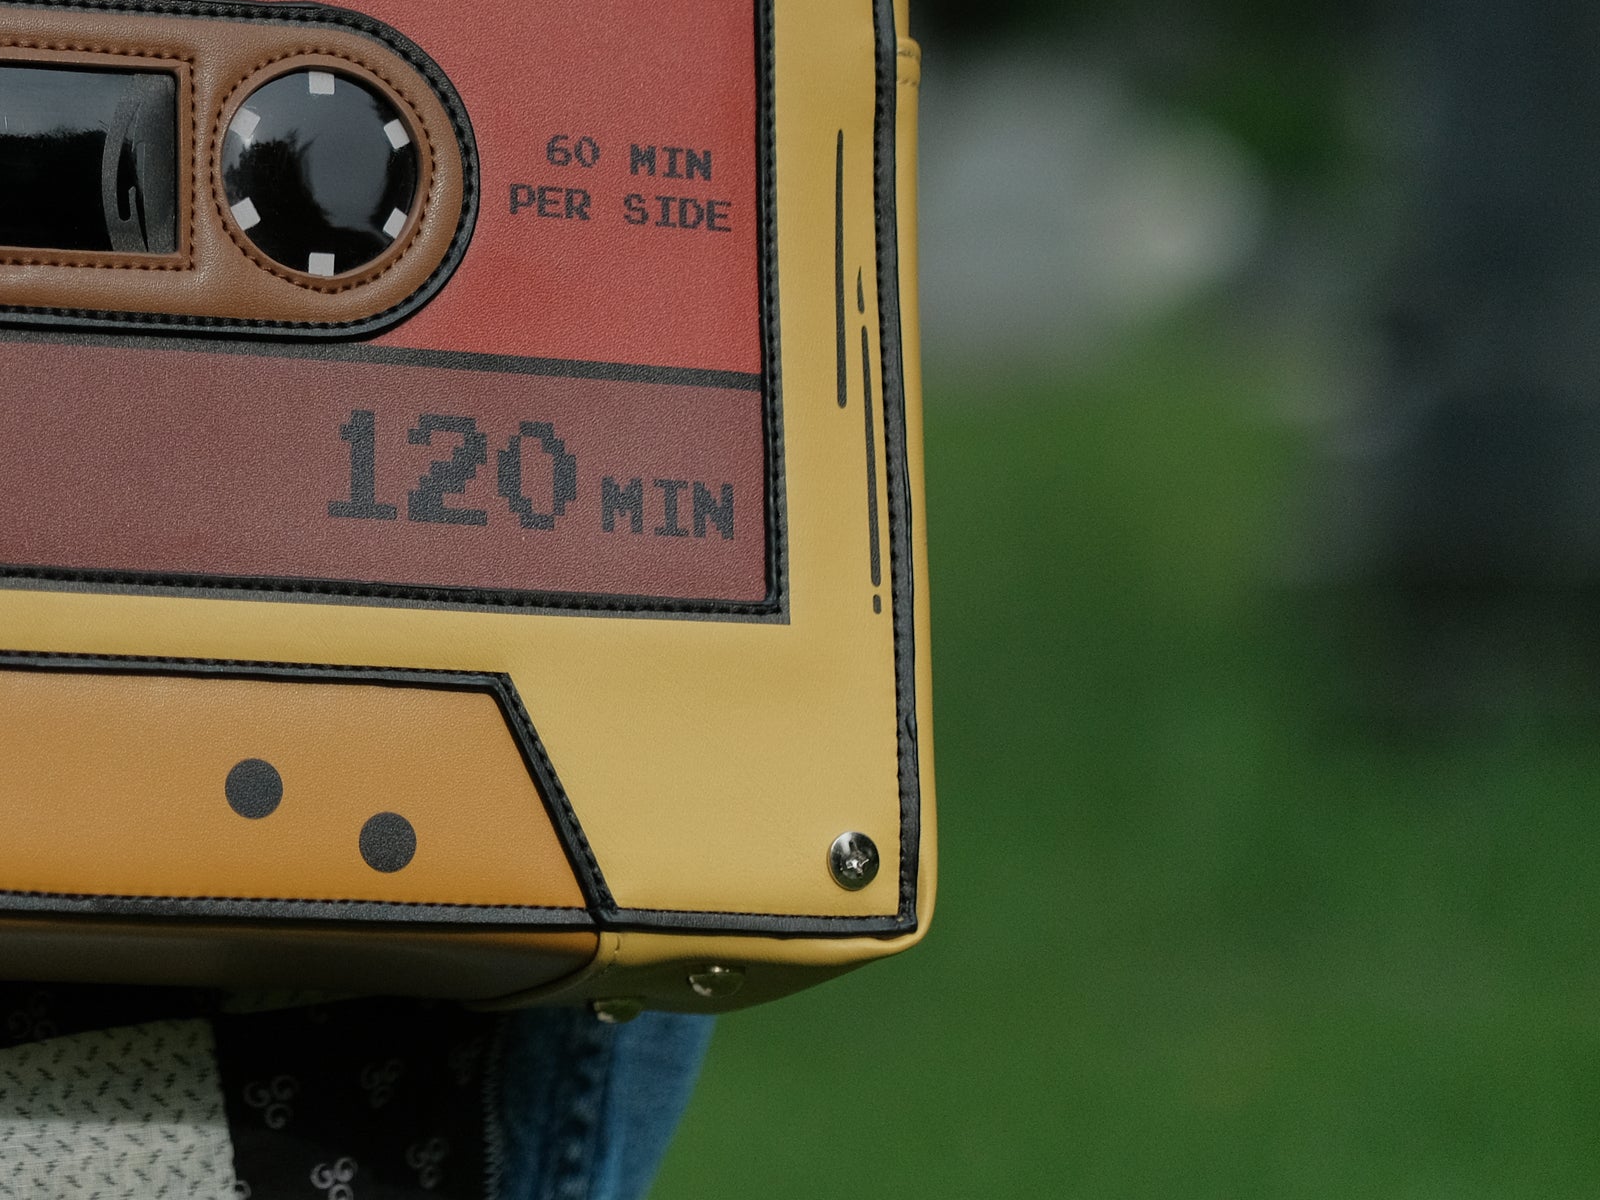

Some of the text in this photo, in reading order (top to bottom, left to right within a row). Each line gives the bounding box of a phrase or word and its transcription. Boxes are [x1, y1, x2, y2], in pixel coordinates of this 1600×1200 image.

[546, 134, 712, 181] 60 MIN
[509, 183, 732, 232] PER SIDE
[327, 409, 735, 540] 120 MIN
